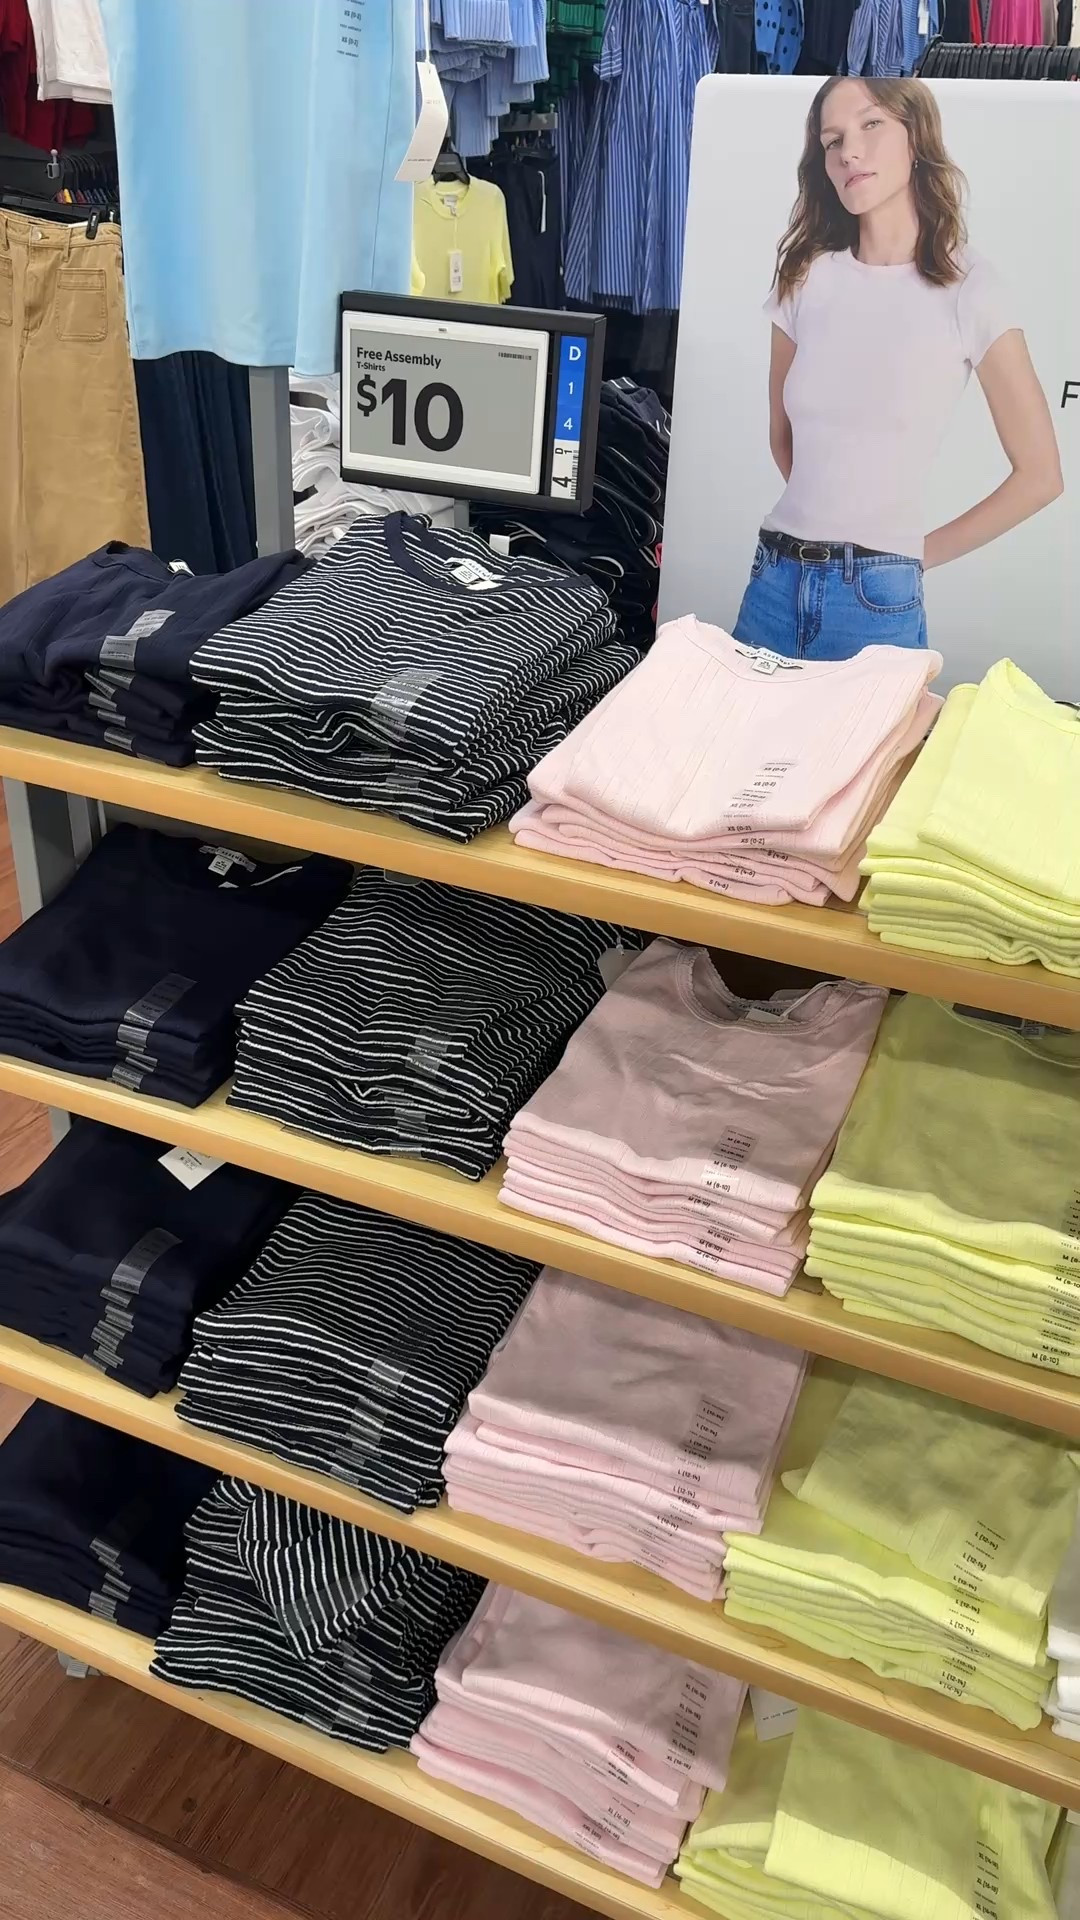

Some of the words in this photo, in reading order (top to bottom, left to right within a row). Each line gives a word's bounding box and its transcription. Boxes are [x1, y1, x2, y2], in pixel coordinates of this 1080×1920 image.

[356, 346, 383, 360] Free
[384, 350, 442, 369] Assembly
[569, 346, 581, 361] D
[356, 361, 386, 372] T-Shirts
[568, 381, 574, 395] 1
[356, 373, 464, 453] $10
[563, 417, 573, 430] 4
[552, 475, 572, 488] 4
